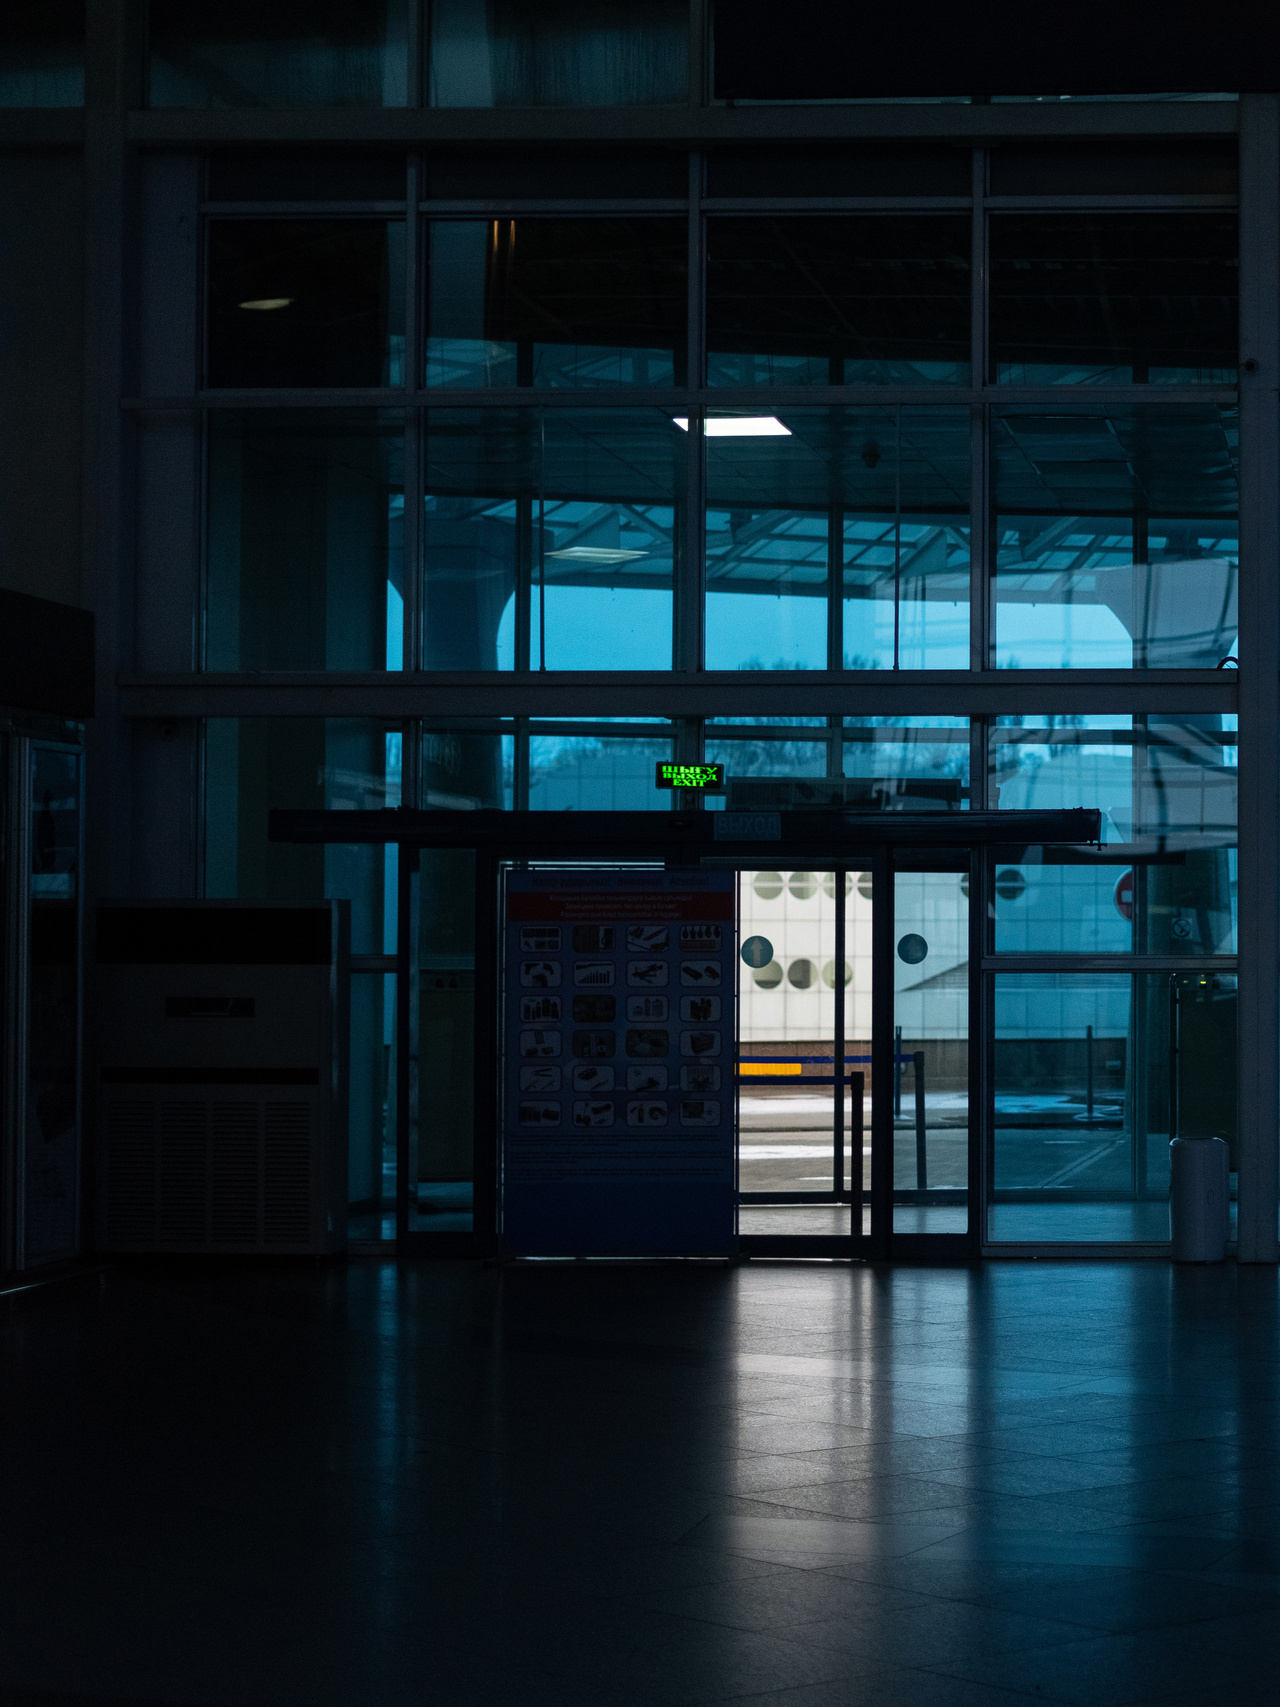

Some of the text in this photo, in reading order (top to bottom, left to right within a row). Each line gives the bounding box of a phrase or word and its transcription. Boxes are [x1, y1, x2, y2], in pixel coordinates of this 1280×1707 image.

[662, 772, 718, 781] ВЫХОД
[673, 779, 707, 787] EXIT
[669, 876, 709, 887] Attention!
